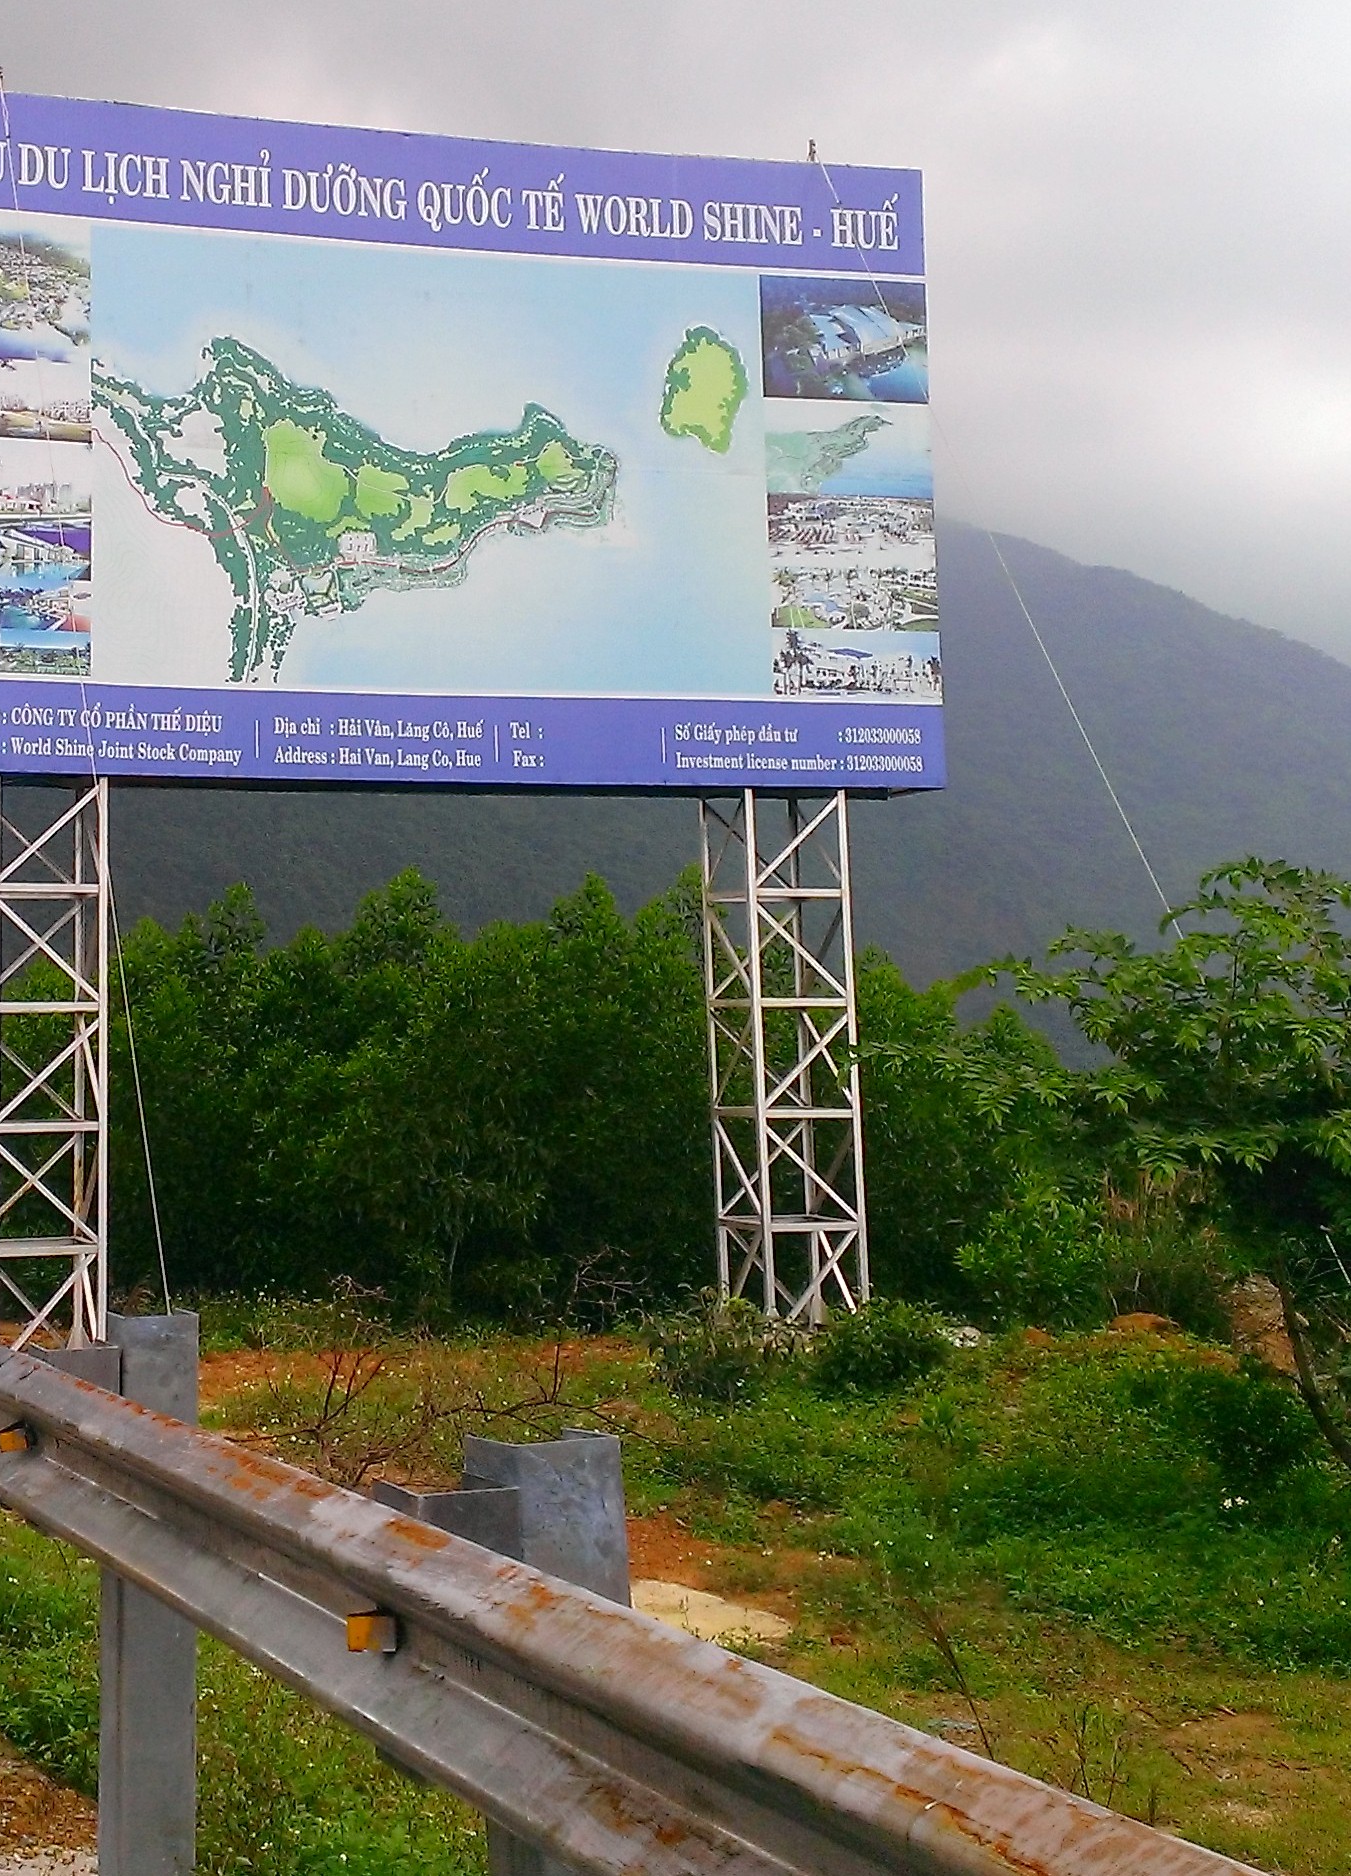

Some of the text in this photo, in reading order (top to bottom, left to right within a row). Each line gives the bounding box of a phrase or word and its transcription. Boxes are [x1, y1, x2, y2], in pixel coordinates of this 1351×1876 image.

[17, 141, 72, 191] DU
[81, 149, 170, 205] LỊCH
[179, 148, 273, 208] NGHỈ
[281, 162, 409, 220] DƯỠNG
[416, 167, 514, 232] QUỐC
[520, 174, 567, 232] TẾ
[575, 192, 694, 239] WORLD
[702, 201, 803, 246] SHINE
[830, 193, 900, 251] HUẾ
[11, 702, 54, 726] CÔNG
[57, 708, 77, 727] TY
[80, 701, 102, 728] CỔ
[105, 703, 148, 730] PHẦN
[150, 706, 182, 732] THẾ
[185, 709, 223, 737] DIỆU
[273, 716, 297, 739] Địa
[337, 718, 362, 737] Hải
[432, 720, 454, 741] Cô,
[456, 718, 485, 739] Huế
[509, 722, 531, 739] Tel
[725, 724, 756, 745] phép
[784, 727, 799, 743] tư
[845, 726, 921, 745] 312033000058
[10, 736, 52, 755] World
[55, 737, 95, 757] Shine
[97, 740, 134, 759] Joint
[137, 741, 176, 760] Stock
[179, 742, 242, 767] Company
[274, 745, 328, 764] Address
[338, 747, 362, 765] Hai
[364, 748, 394, 769] Van,
[396, 749, 430, 771] Lang
[432, 749, 453, 770] Co,
[455, 750, 482, 767] Hue
[513, 750, 537, 767] Fax
[675, 752, 743, 769] Investment
[746, 752, 788, 770] license
[791, 754, 837, 771] number
[846, 754, 923, 772] 312033000058
